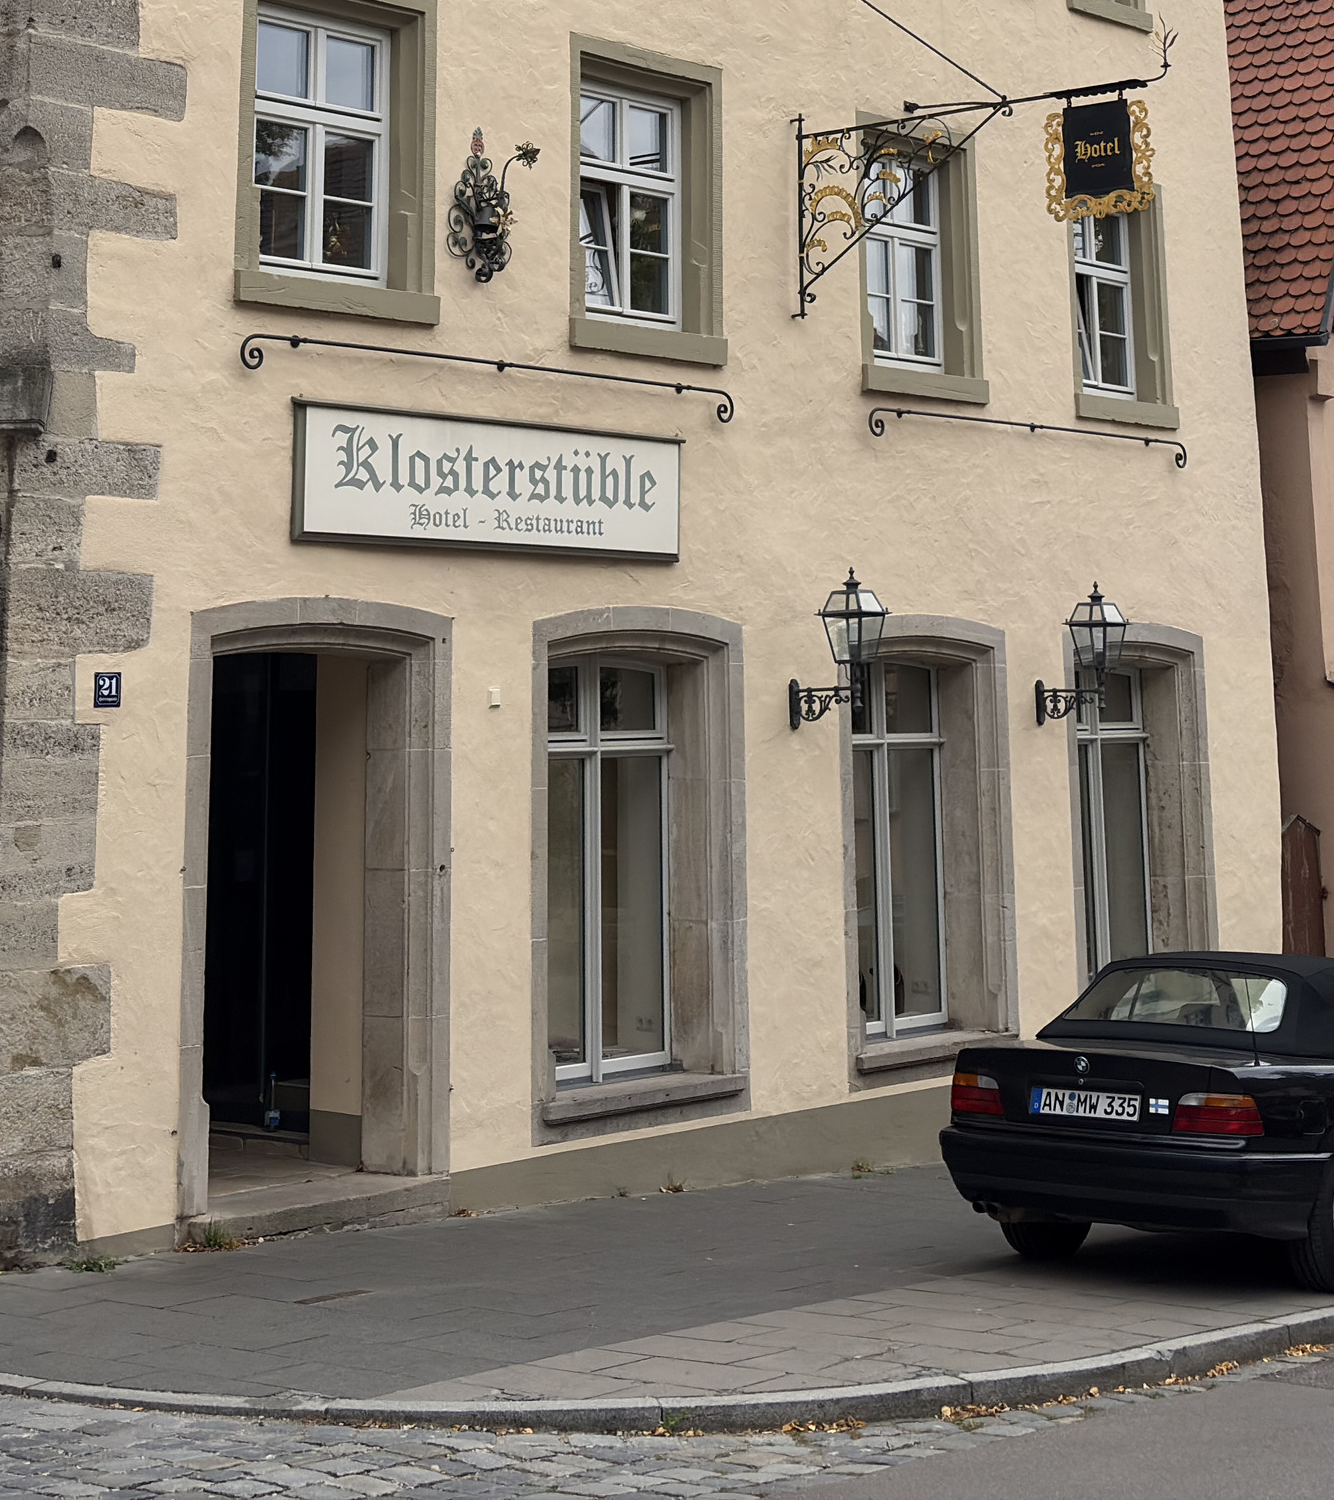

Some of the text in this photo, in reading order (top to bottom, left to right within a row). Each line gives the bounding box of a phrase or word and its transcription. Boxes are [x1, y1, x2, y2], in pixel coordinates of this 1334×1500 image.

[1074, 136, 1121, 163] Hotel
[331, 424, 658, 512] Klosterstüble
[409, 503, 470, 530] Hotel
[493, 509, 604, 537] Restaurant
[99, 677, 117, 695] 21
[1042, 1091, 1066, 1113] AN
[1076, 1093, 1101, 1115] MW
[1103, 1096, 1139, 1118] 335
